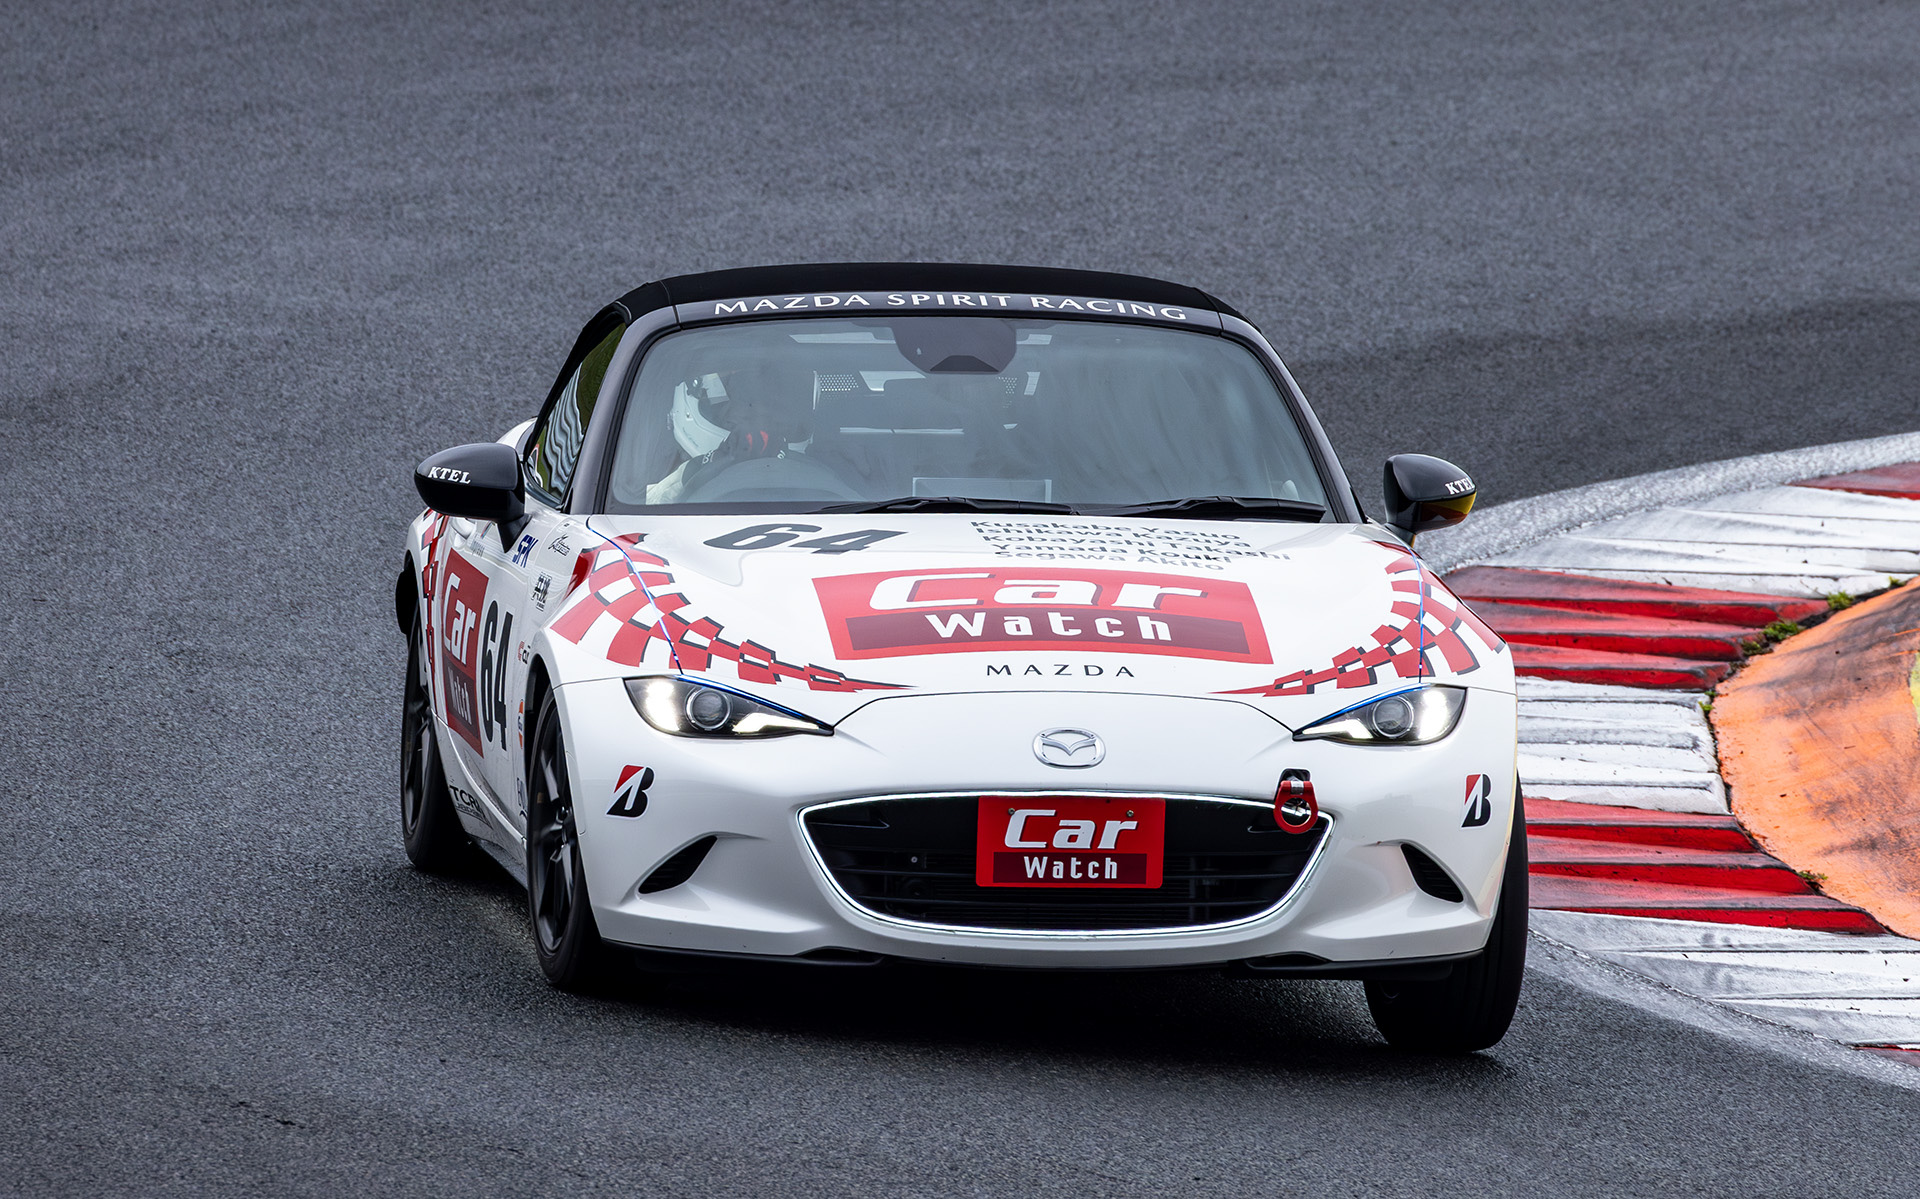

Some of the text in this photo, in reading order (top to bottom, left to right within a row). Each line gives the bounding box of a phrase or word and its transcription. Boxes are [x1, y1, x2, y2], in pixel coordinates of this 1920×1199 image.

[714, 293, 1187, 321] MAZDA SPIRIT RACING
[427, 466, 471, 485] KTEL
[702, 523, 909, 555] 64
[970, 521, 1241, 540] Kusakabe Yasuo
[976, 528, 1251, 548] Ishikawa Kazuya
[982, 535, 1291, 560] Kobayashi Takashi
[992, 543, 1232, 563] Yamada Kouki
[994, 551, 1224, 571] Segawa Akito
[869, 572, 1209, 611] Car
[444, 572, 477, 666] Car
[924, 612, 1173, 641] Watch
[481, 600, 514, 751] 64
[986, 664, 1135, 678] MAZDA
[1004, 809, 1138, 850] Car
[1023, 856, 1118, 880] Watch
